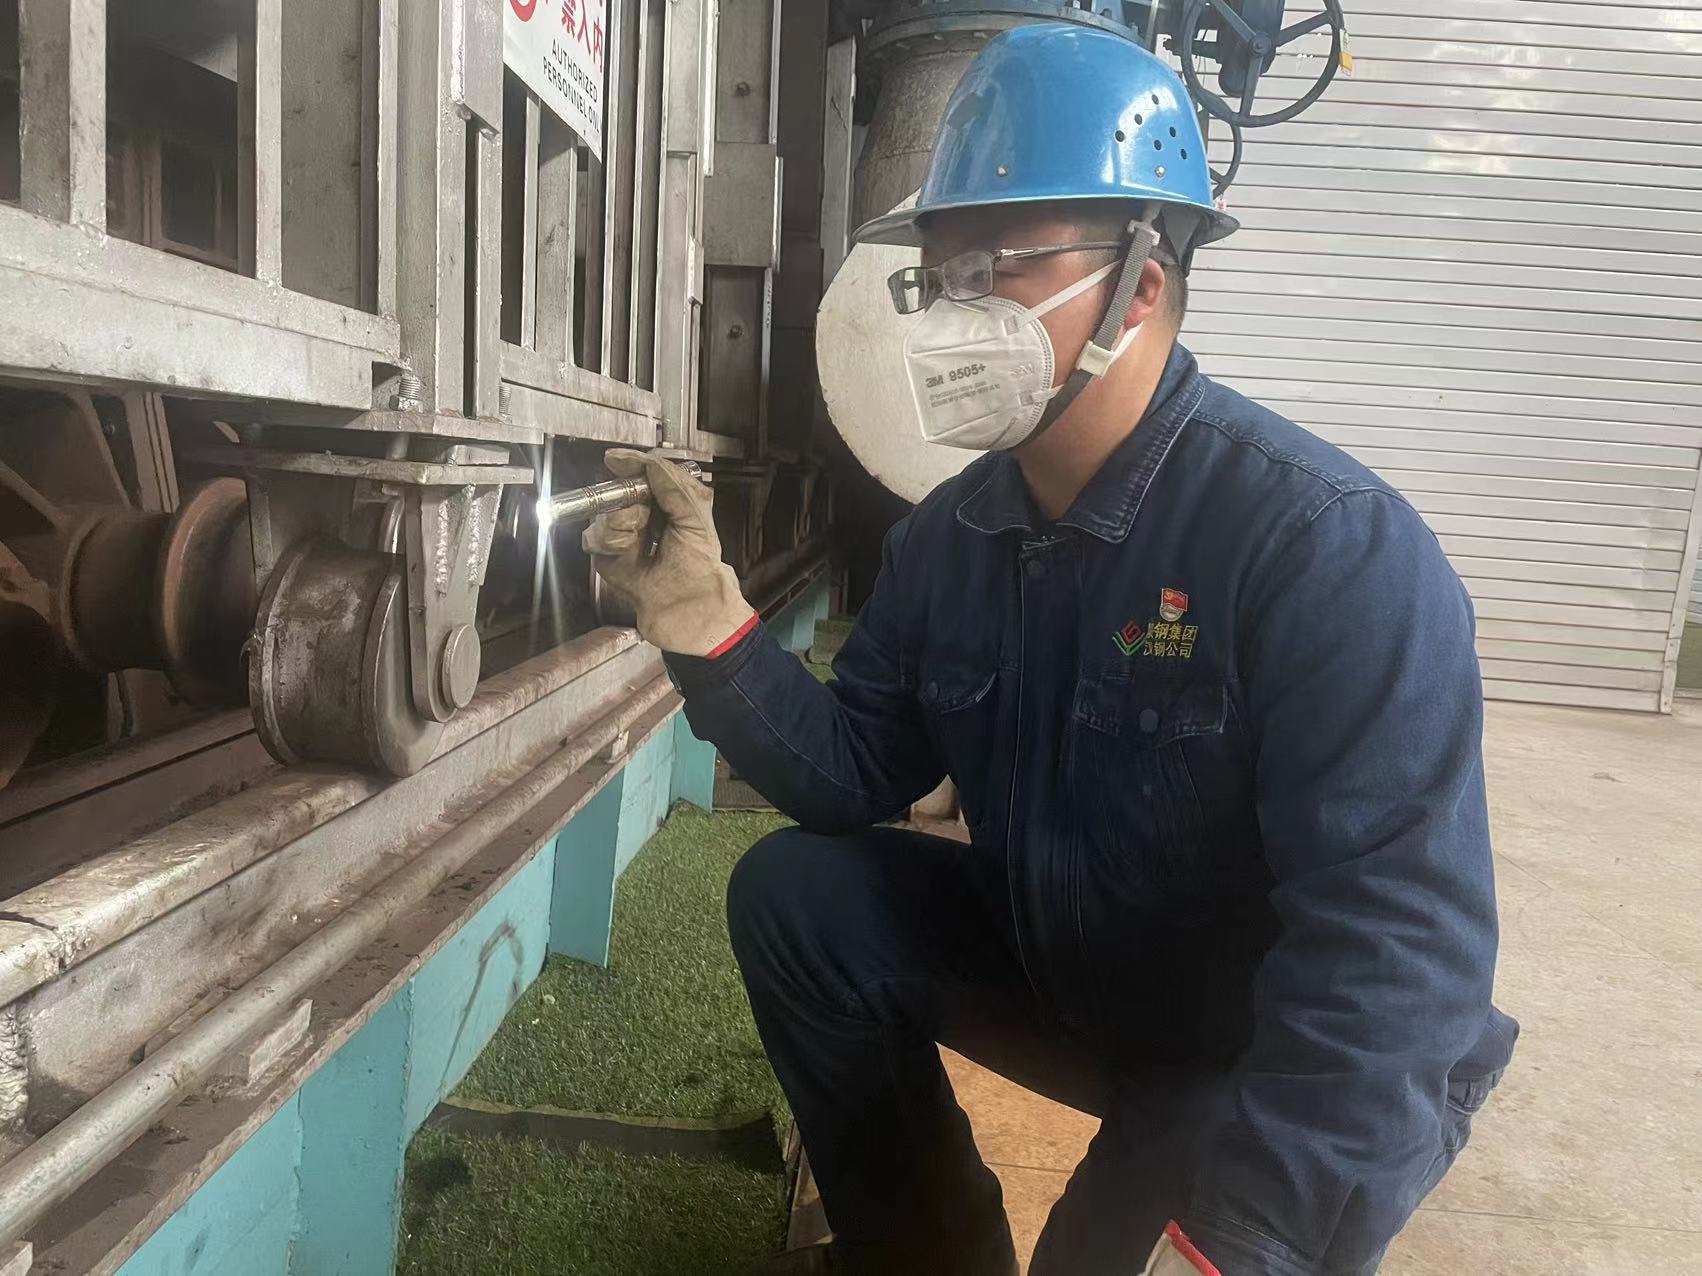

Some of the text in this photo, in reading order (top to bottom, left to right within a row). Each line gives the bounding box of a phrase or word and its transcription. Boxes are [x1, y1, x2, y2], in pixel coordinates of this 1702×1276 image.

[546, 0, 603, 73] 禁入内
[543, 56, 600, 133] PERSONNEL ONL
[552, 39, 598, 103] AUTHORIZED
[925, 374, 944, 388] 3M
